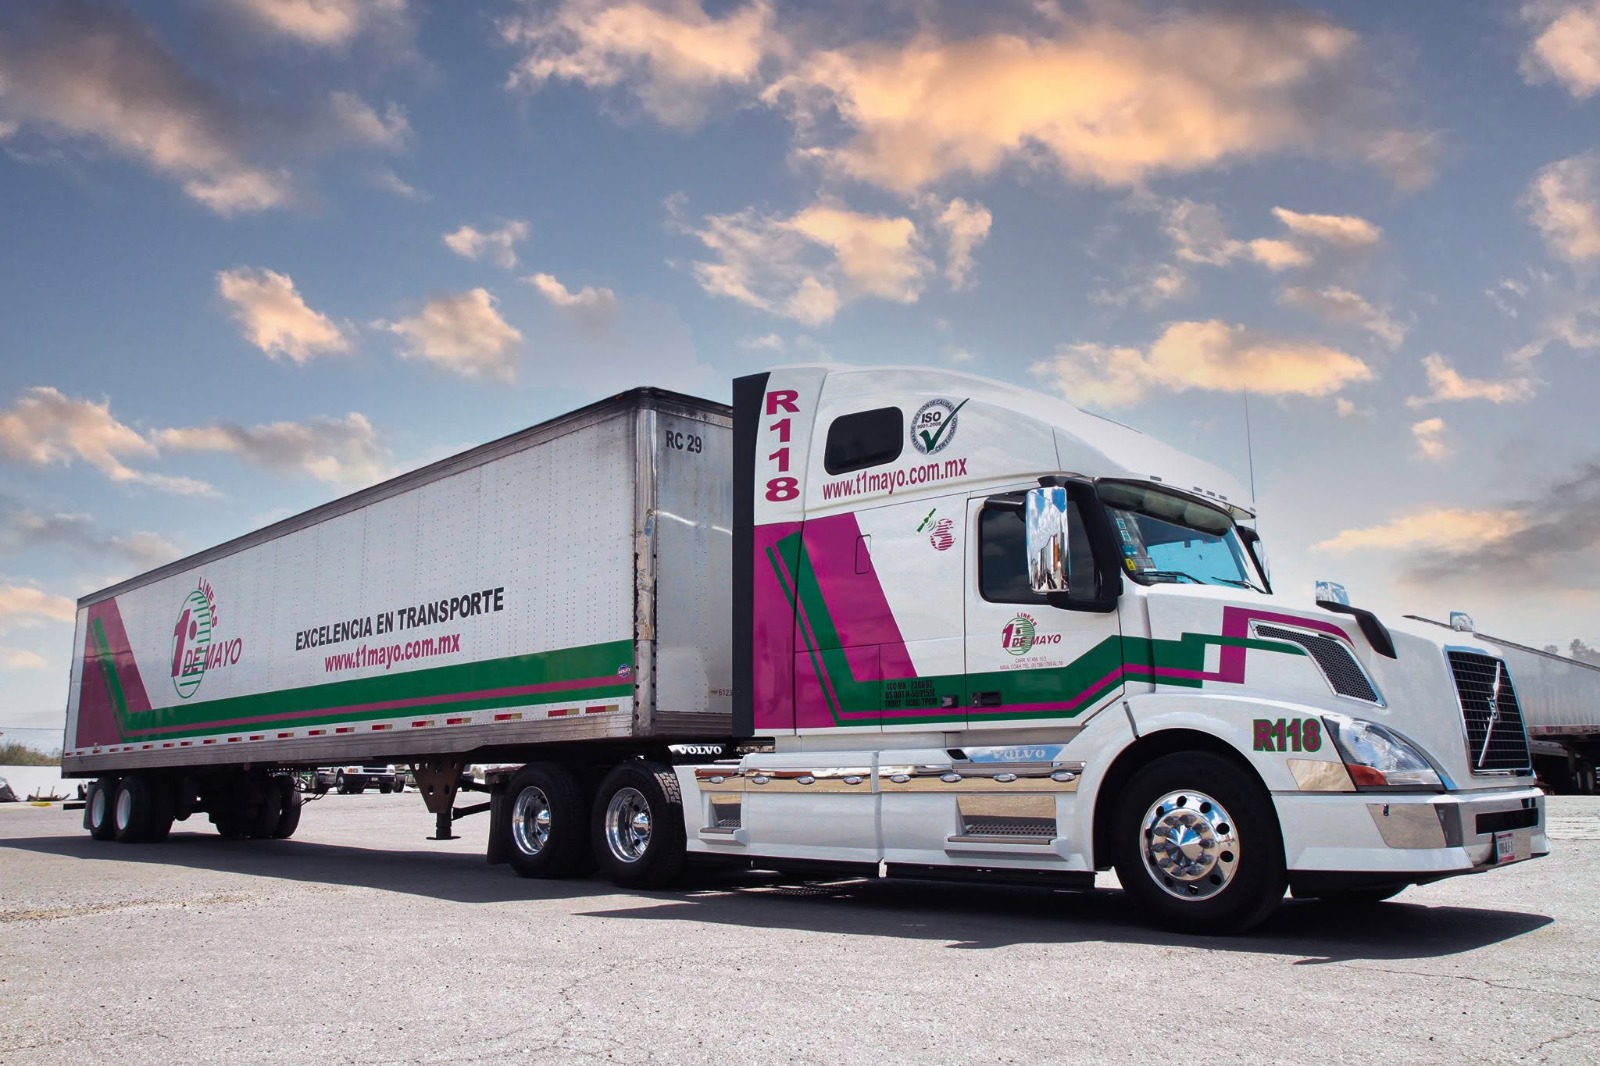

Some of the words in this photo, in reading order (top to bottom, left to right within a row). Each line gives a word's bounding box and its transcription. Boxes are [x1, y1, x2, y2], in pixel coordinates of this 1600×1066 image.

[921, 411, 942, 423] ISO
[666, 430, 684, 451] RC
[687, 434, 703, 454] 29
[765, 389, 800, 502] R118
[823, 457, 967, 500] www.t1mayo.com.mx
[295, 617, 373, 650] EXCELENCIA
[376, 611, 395, 635] EN
[398, 586, 504, 629] TRANSPORTE
[182, 647, 203, 675] DE
[203, 638, 242, 671] MAYO
[324, 633, 461, 672] www.t1mayo.com.mx
[1012, 636, 1026, 648] DE
[1031, 634, 1061, 645] MAYO
[680, 746, 722, 755] VOLVO
[1252, 718, 1322, 752] R118
[991, 749, 1046, 760] VOLVO
